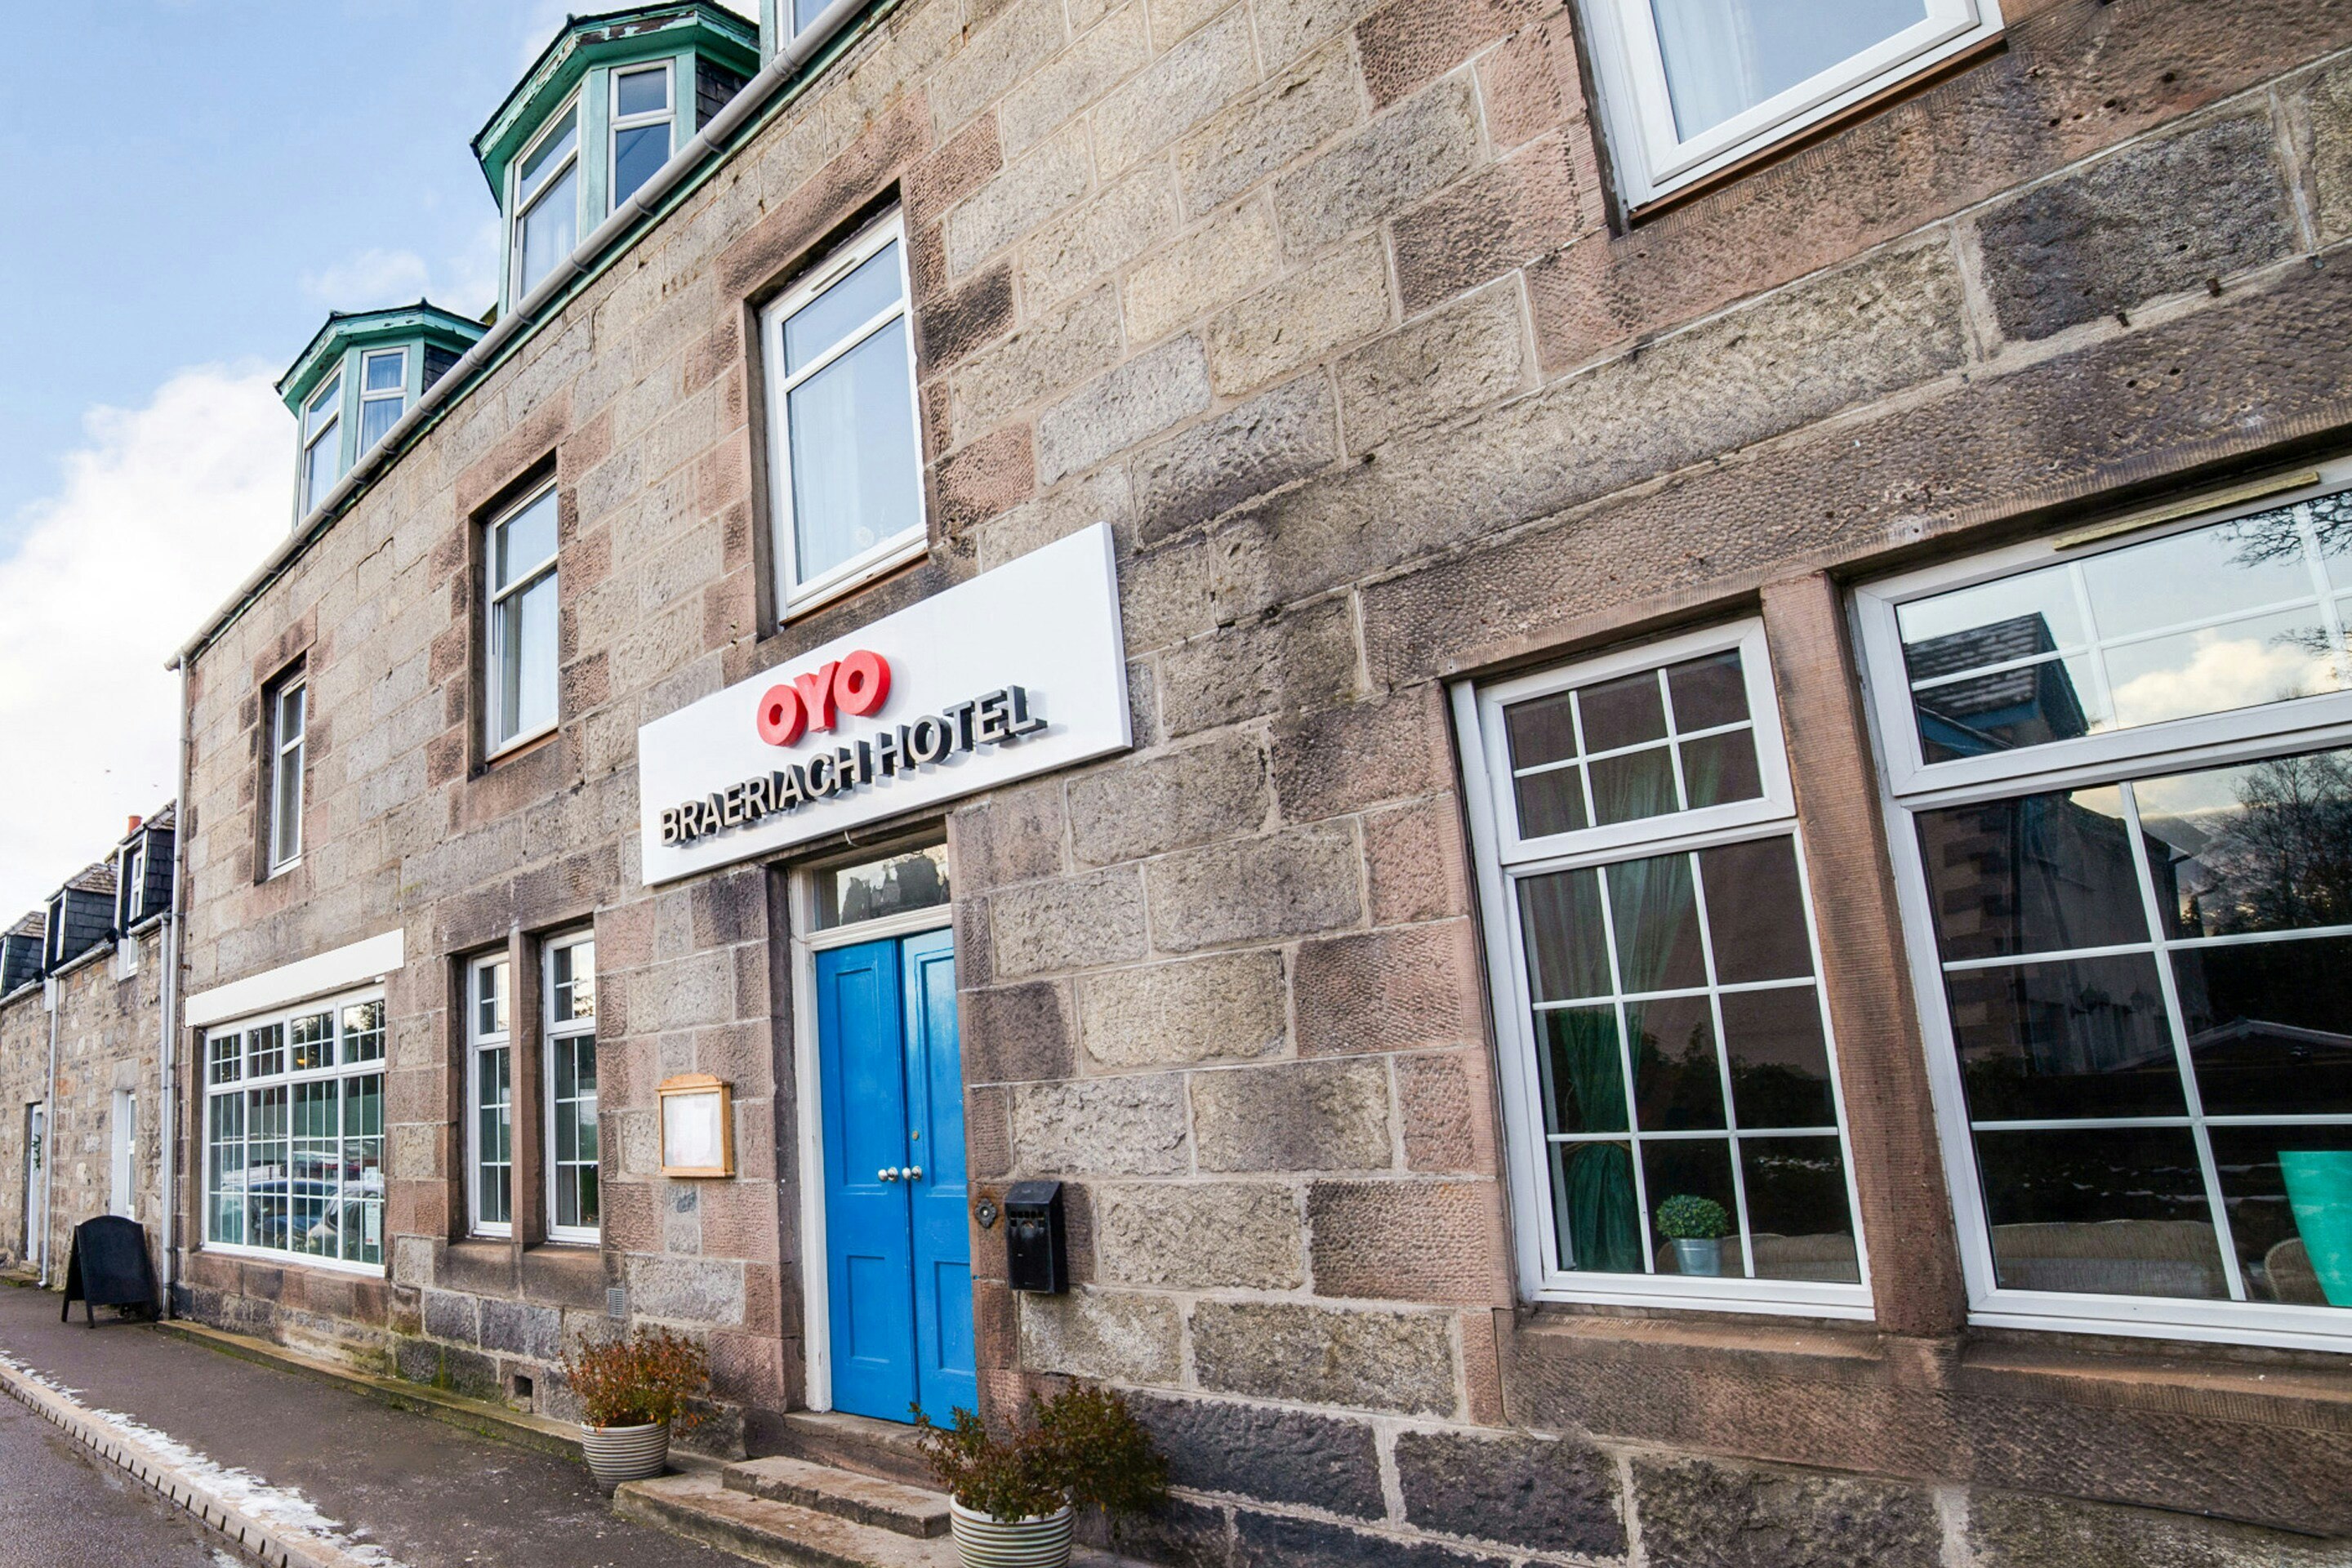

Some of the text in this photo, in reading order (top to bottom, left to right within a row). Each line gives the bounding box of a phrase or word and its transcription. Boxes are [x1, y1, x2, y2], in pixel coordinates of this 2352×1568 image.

[758, 650, 890, 746] OYO
[661, 685, 1047, 847] BRAERIACH HOTEL
